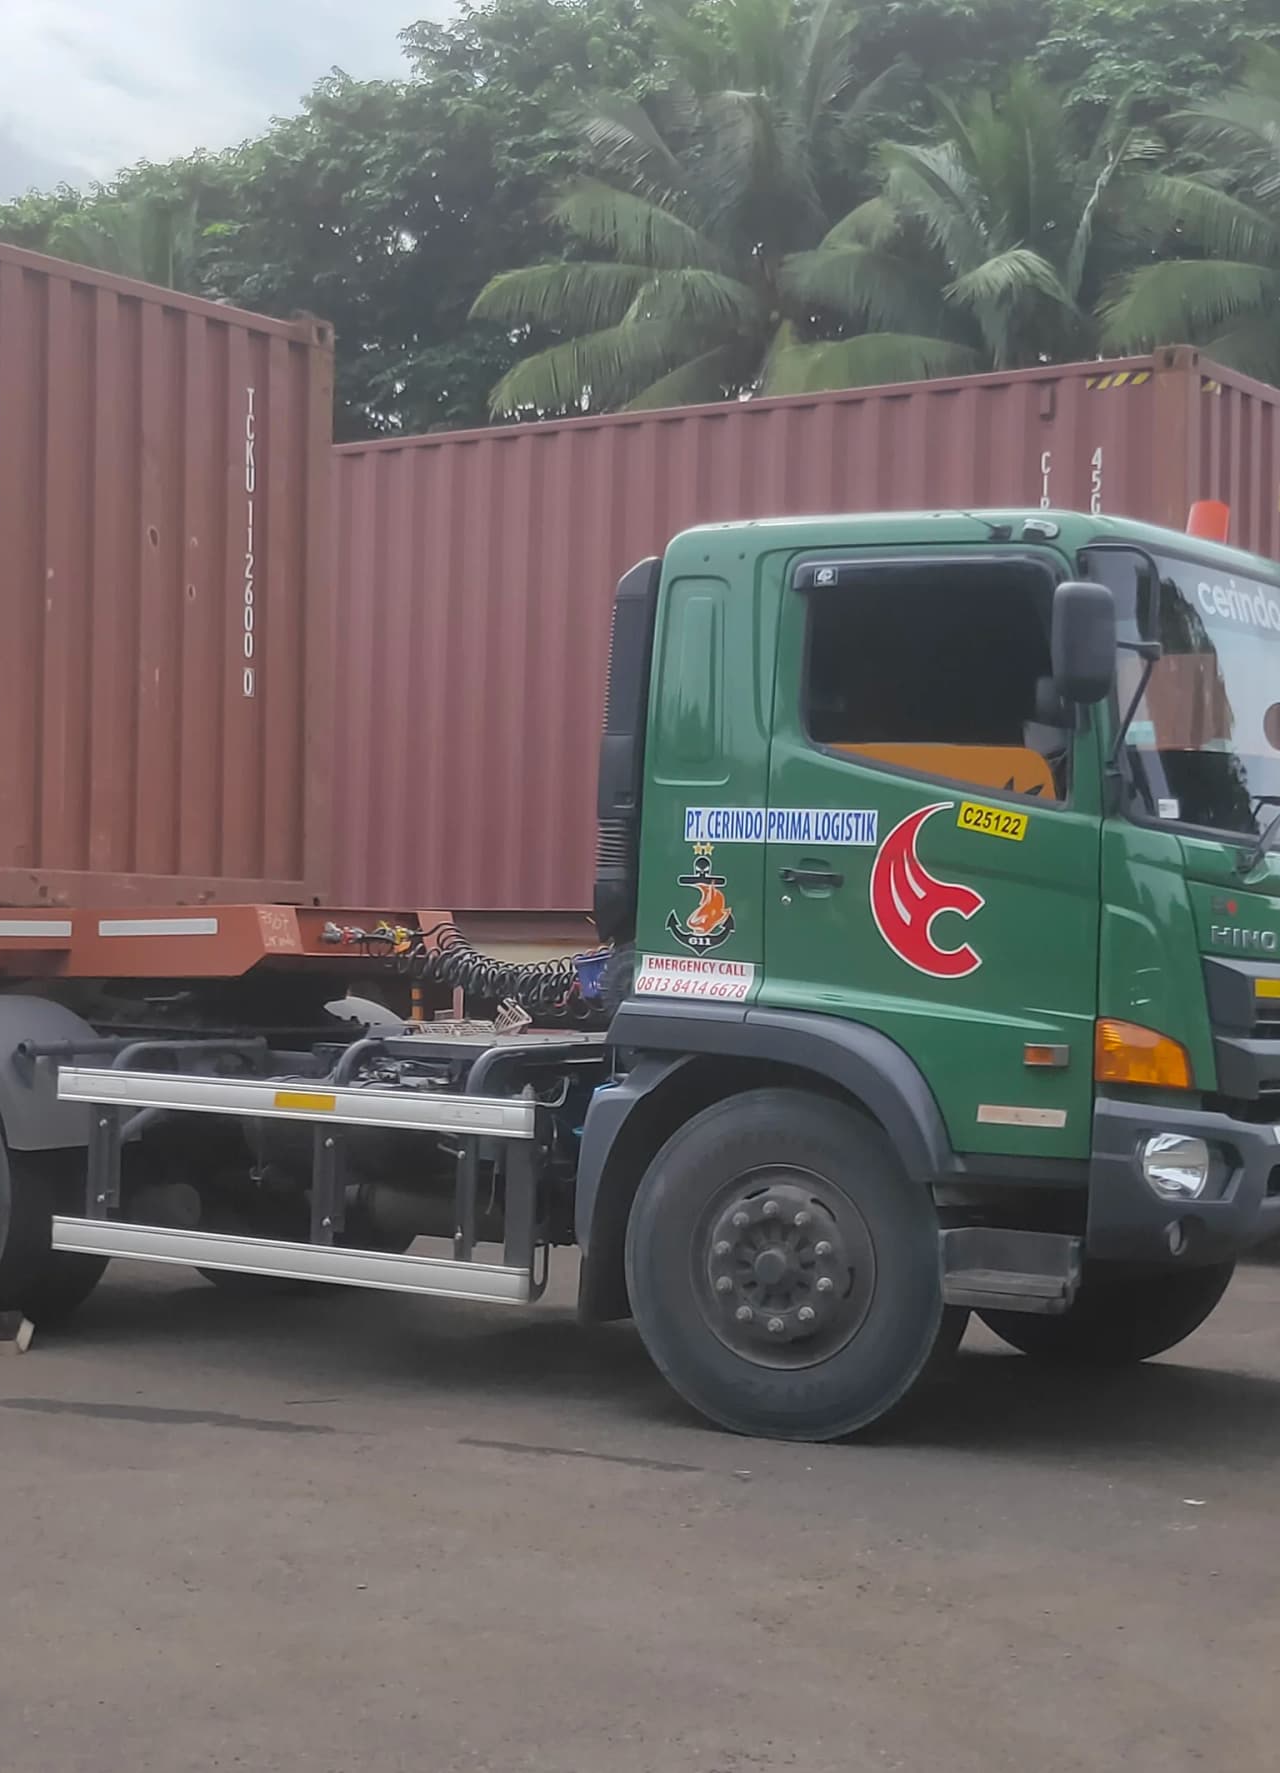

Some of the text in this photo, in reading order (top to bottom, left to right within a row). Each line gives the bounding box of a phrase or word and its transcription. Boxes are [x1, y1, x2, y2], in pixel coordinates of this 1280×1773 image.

[245, 387, 255, 493] TCKU
[244, 500, 254, 658] 112600
[686, 810, 876, 842] PT. CERINDO PRIMA LOGISTIK
[963, 807, 1022, 836] C25122
[1210, 924, 1278, 951] HINO
[648, 957, 746, 977] EMERGENCY CALL
[636, 976, 748, 998] 0813 8414 6678
